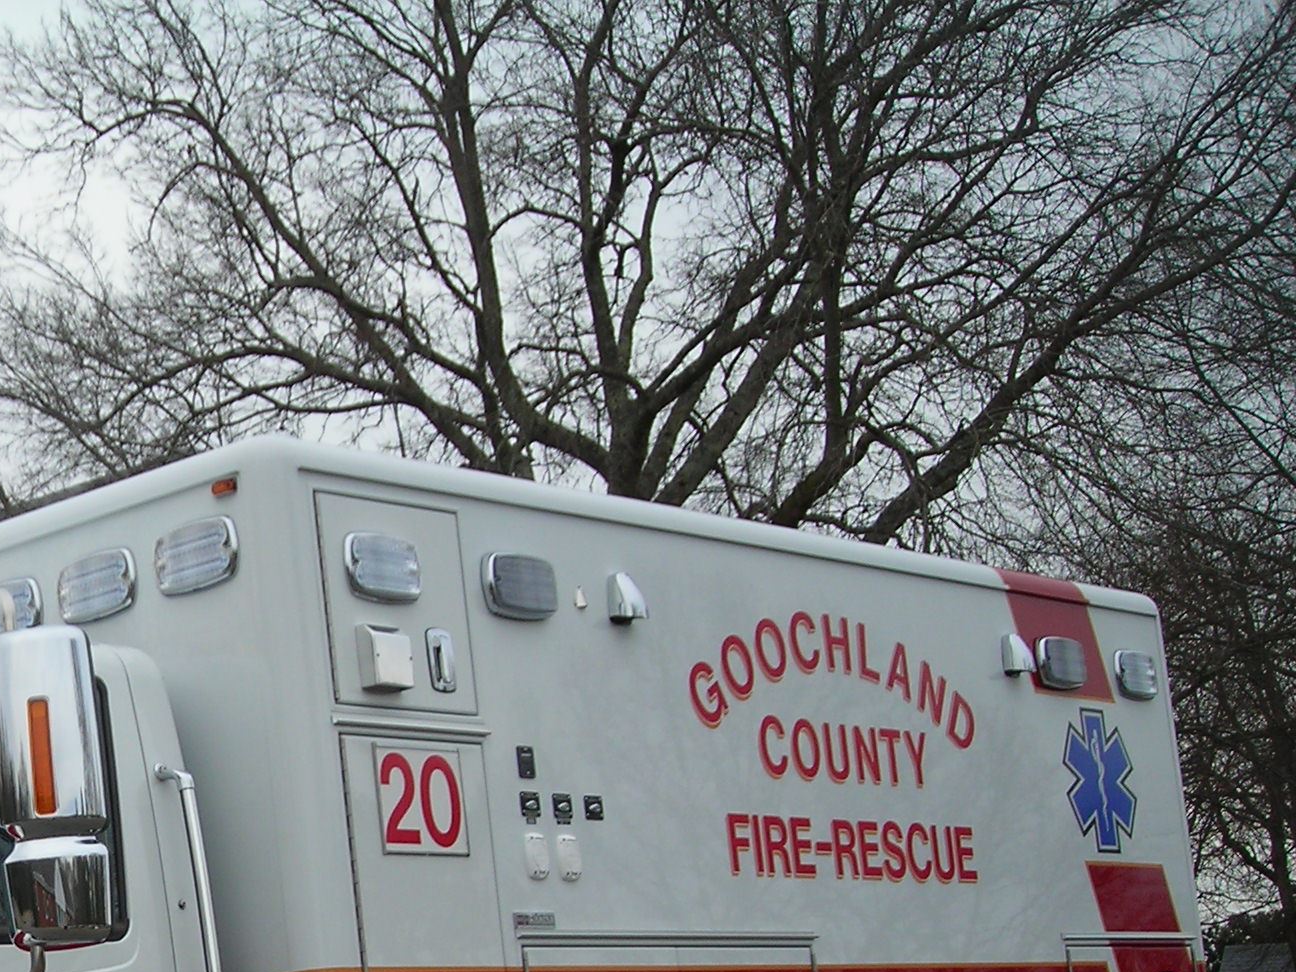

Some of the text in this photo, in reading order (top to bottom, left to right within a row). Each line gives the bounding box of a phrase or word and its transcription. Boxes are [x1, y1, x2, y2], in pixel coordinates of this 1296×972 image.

[688, 610, 975, 749] GOOCHLAND
[758, 714, 926, 789] COUNTY
[379, 752, 462, 849] 20
[725, 812, 979, 885] FIRE-RESCUE
